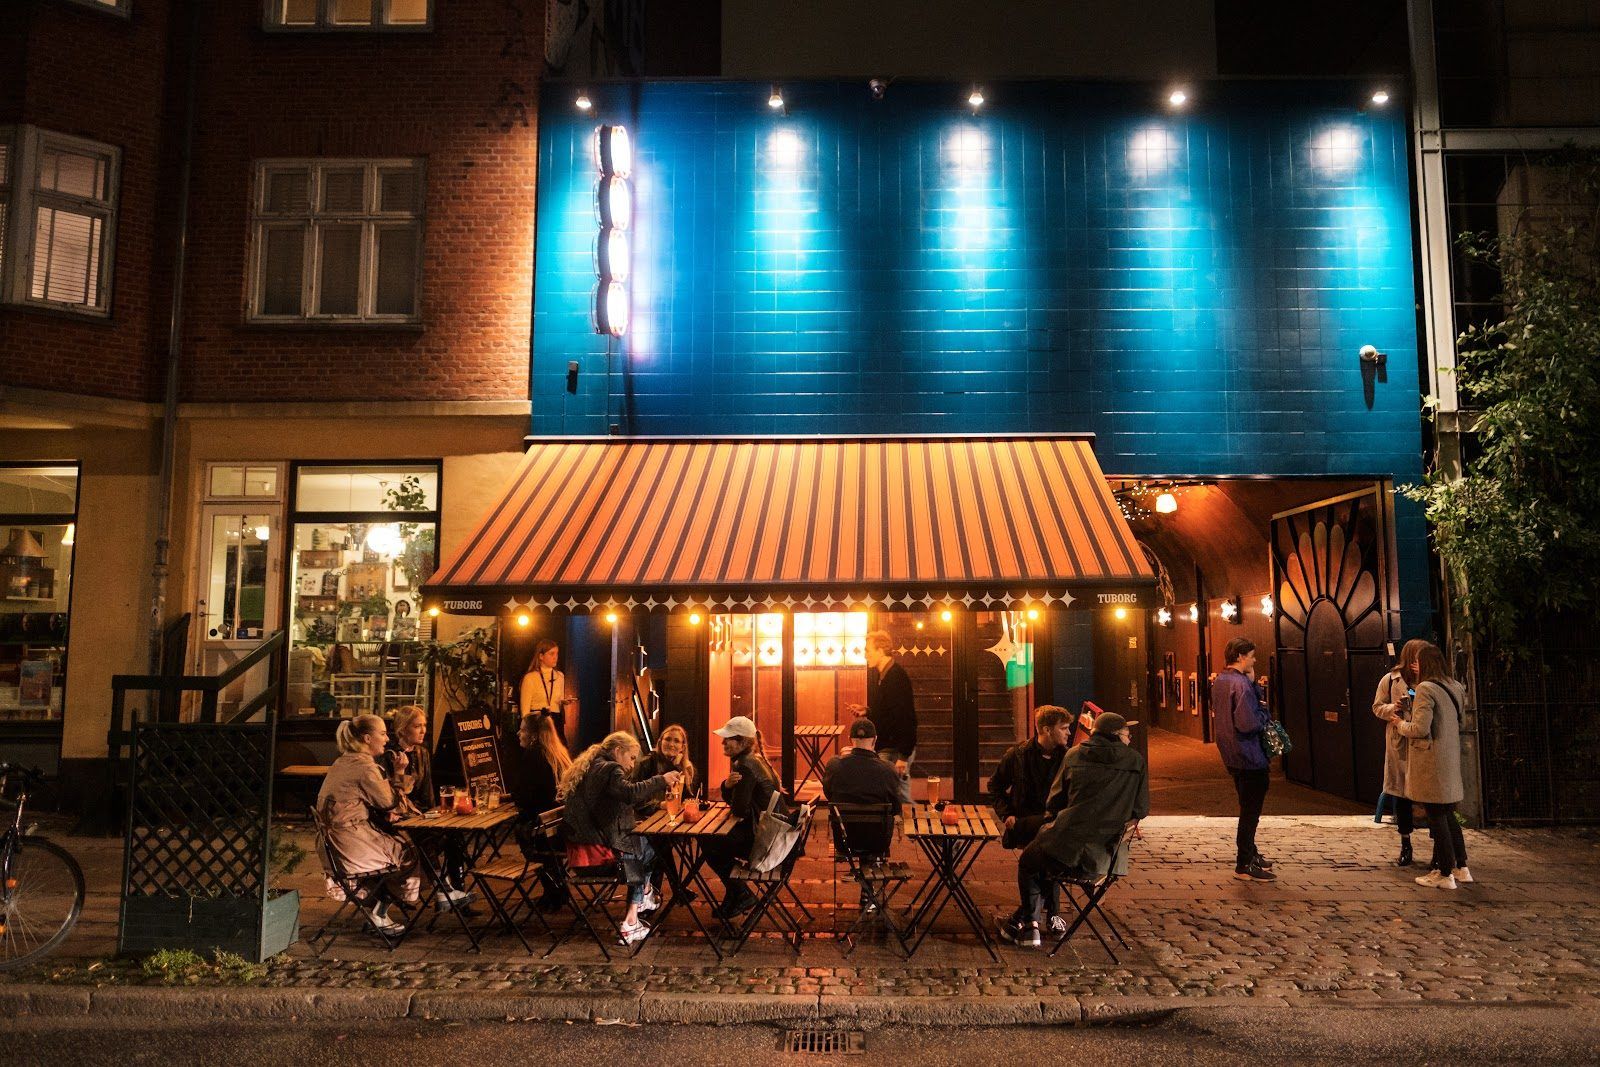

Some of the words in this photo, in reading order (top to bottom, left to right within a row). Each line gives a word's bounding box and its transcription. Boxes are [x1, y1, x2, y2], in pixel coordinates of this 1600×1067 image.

[1097, 593, 1137, 604] TUBORG
[443, 600, 483, 610] TUBORG
[457, 719, 483, 732] TUBORG
